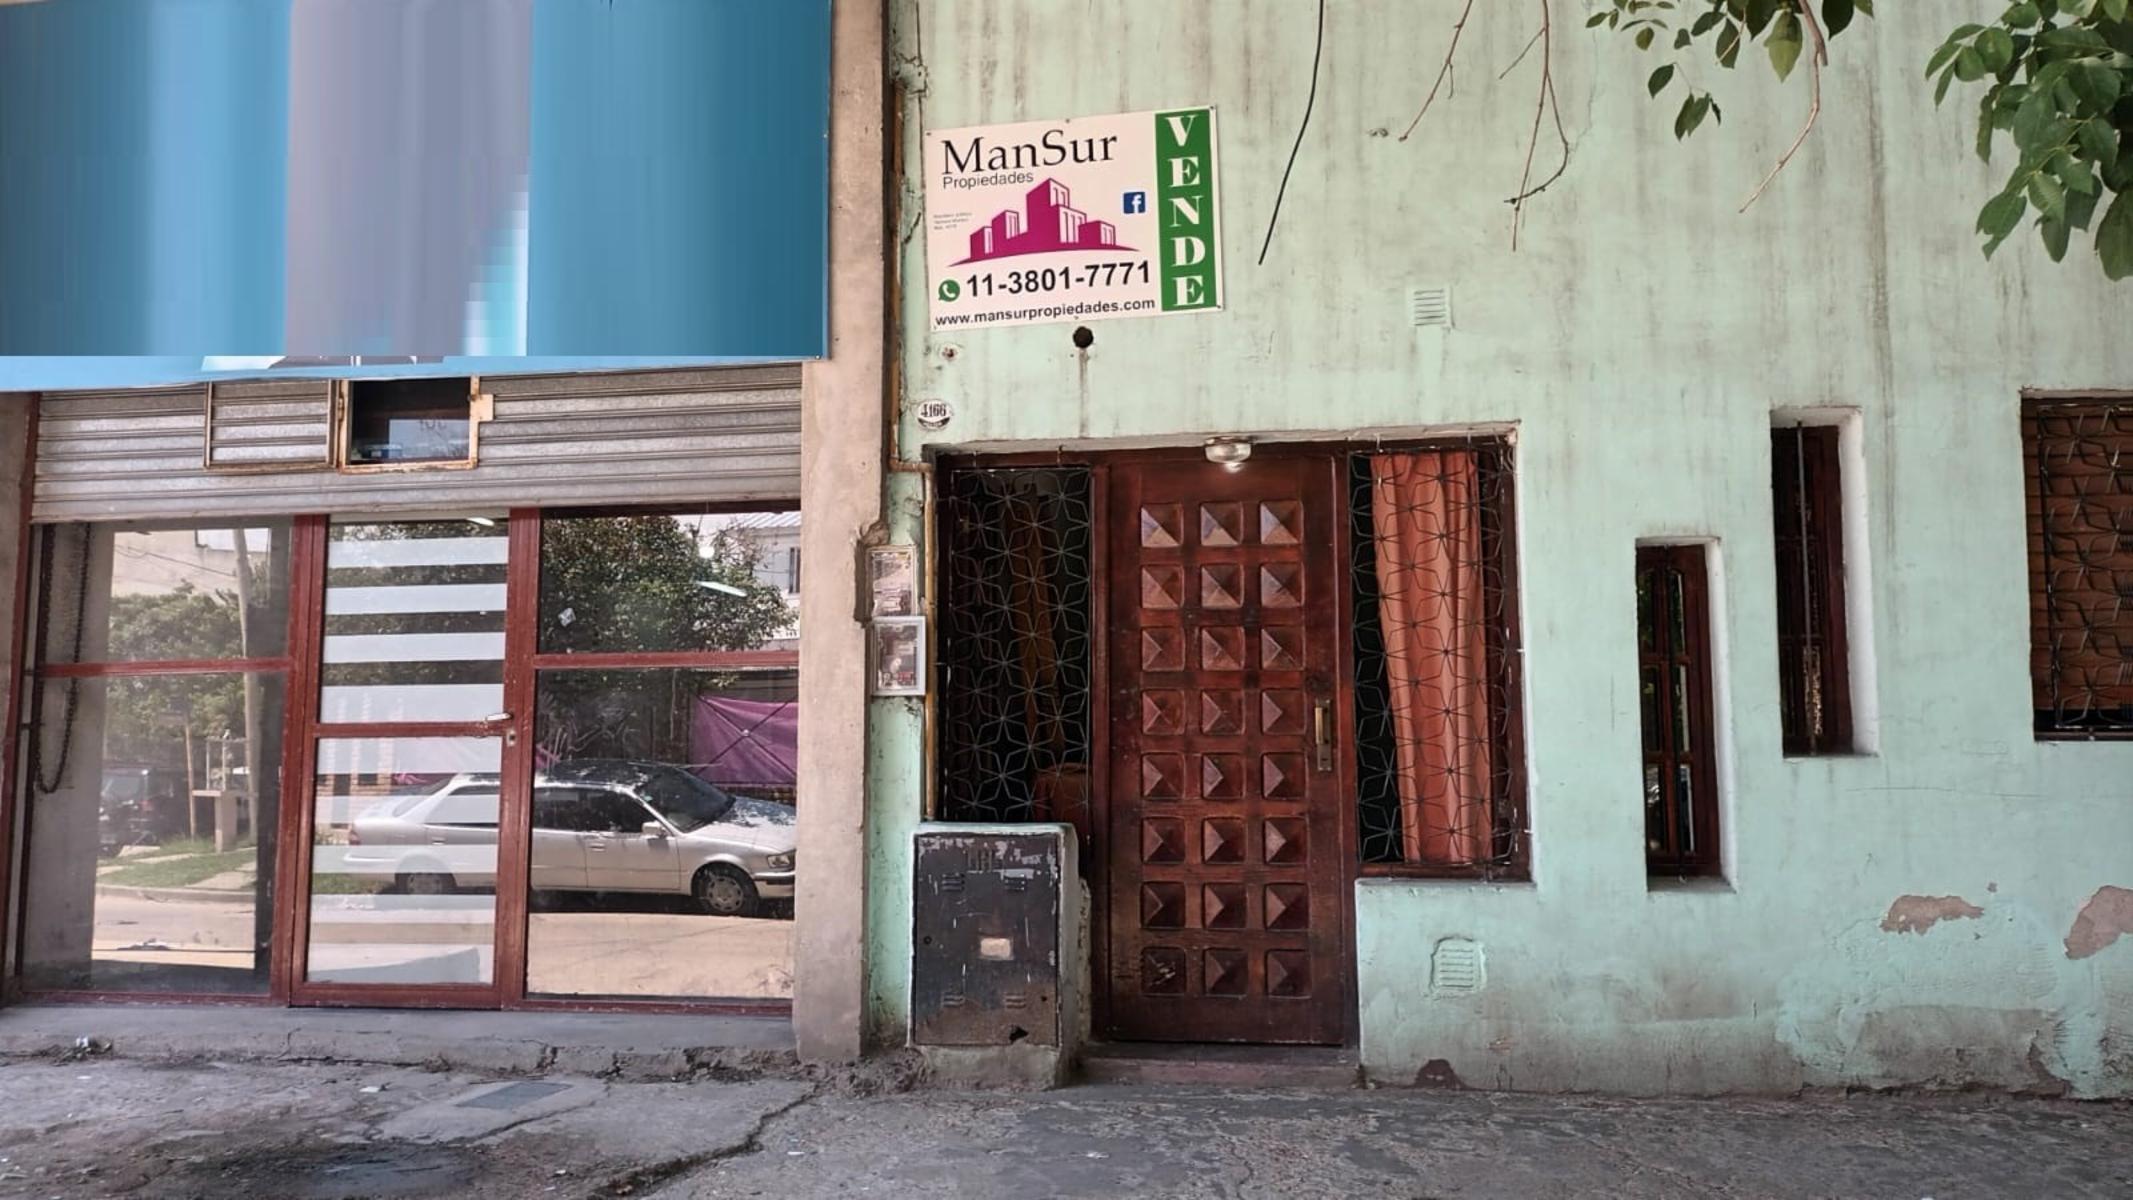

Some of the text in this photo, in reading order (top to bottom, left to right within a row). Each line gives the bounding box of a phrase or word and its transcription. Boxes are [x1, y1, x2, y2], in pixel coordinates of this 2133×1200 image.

[942, 129, 1117, 175] ManSur
[943, 171, 1034, 190] Propiedades
[1165, 114, 1206, 307] VENDE
[966, 260, 1150, 297] 11-3801-7771
[935, 300, 1156, 326] www.mansurpropiedades.com
[920, 403, 947, 417] 4166
